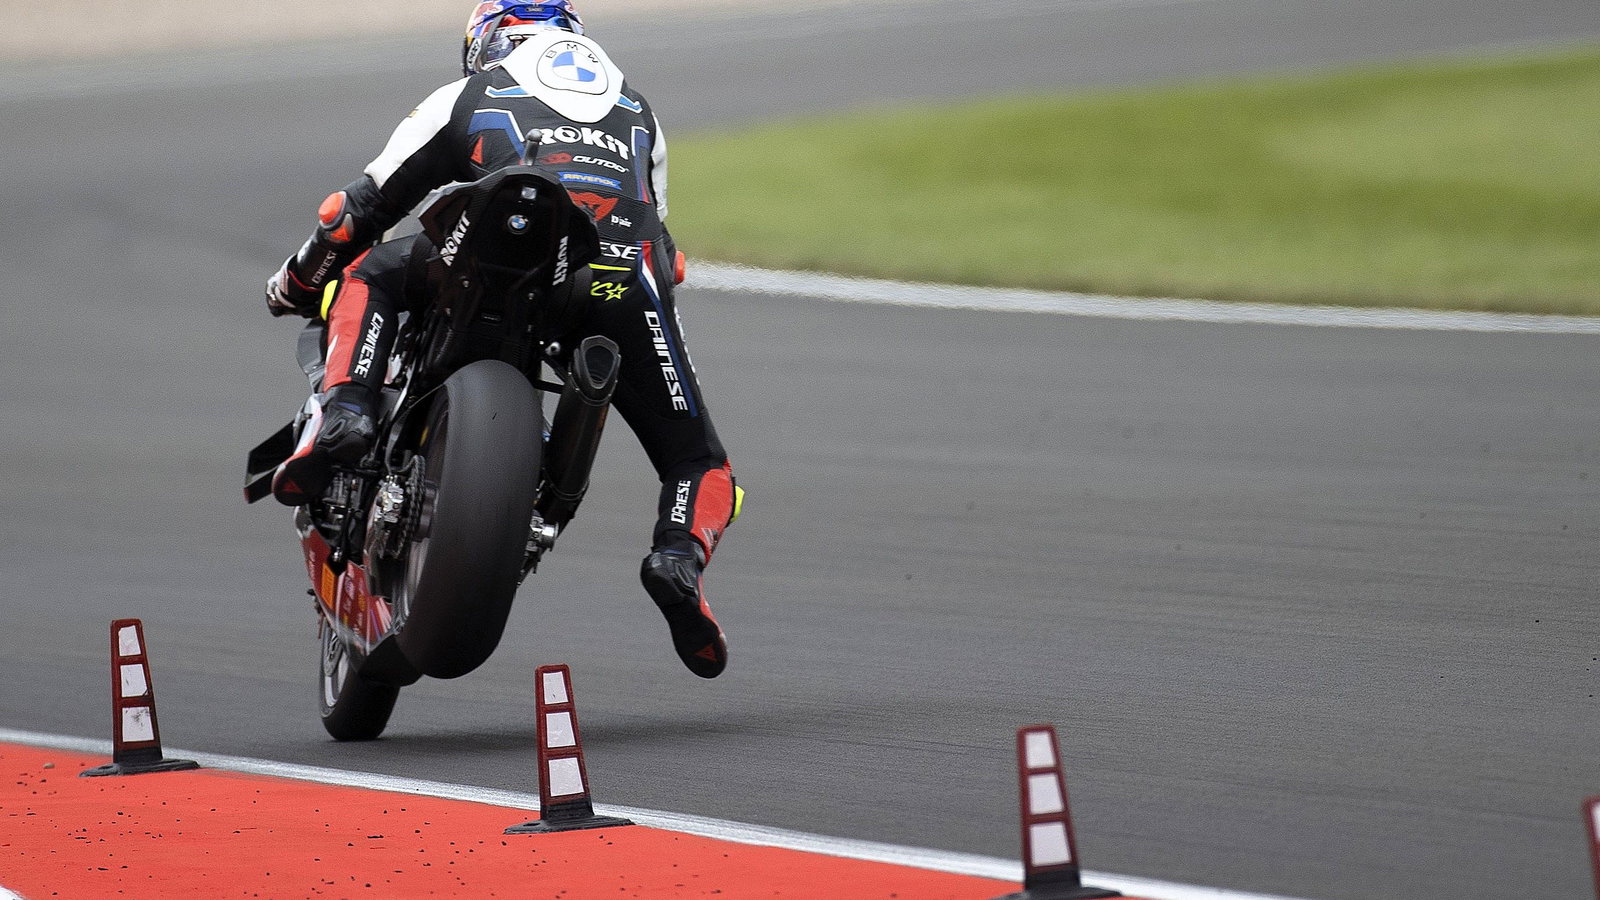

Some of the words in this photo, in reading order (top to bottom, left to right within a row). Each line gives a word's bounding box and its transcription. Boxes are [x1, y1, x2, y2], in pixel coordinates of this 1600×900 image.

[545, 43, 598, 63] BMW
[572, 155, 629, 173] OUTDO
[354, 312, 384, 378] DAINESE
[644, 311, 688, 411] DAINESE
[671, 480, 691, 524] DAINESE
